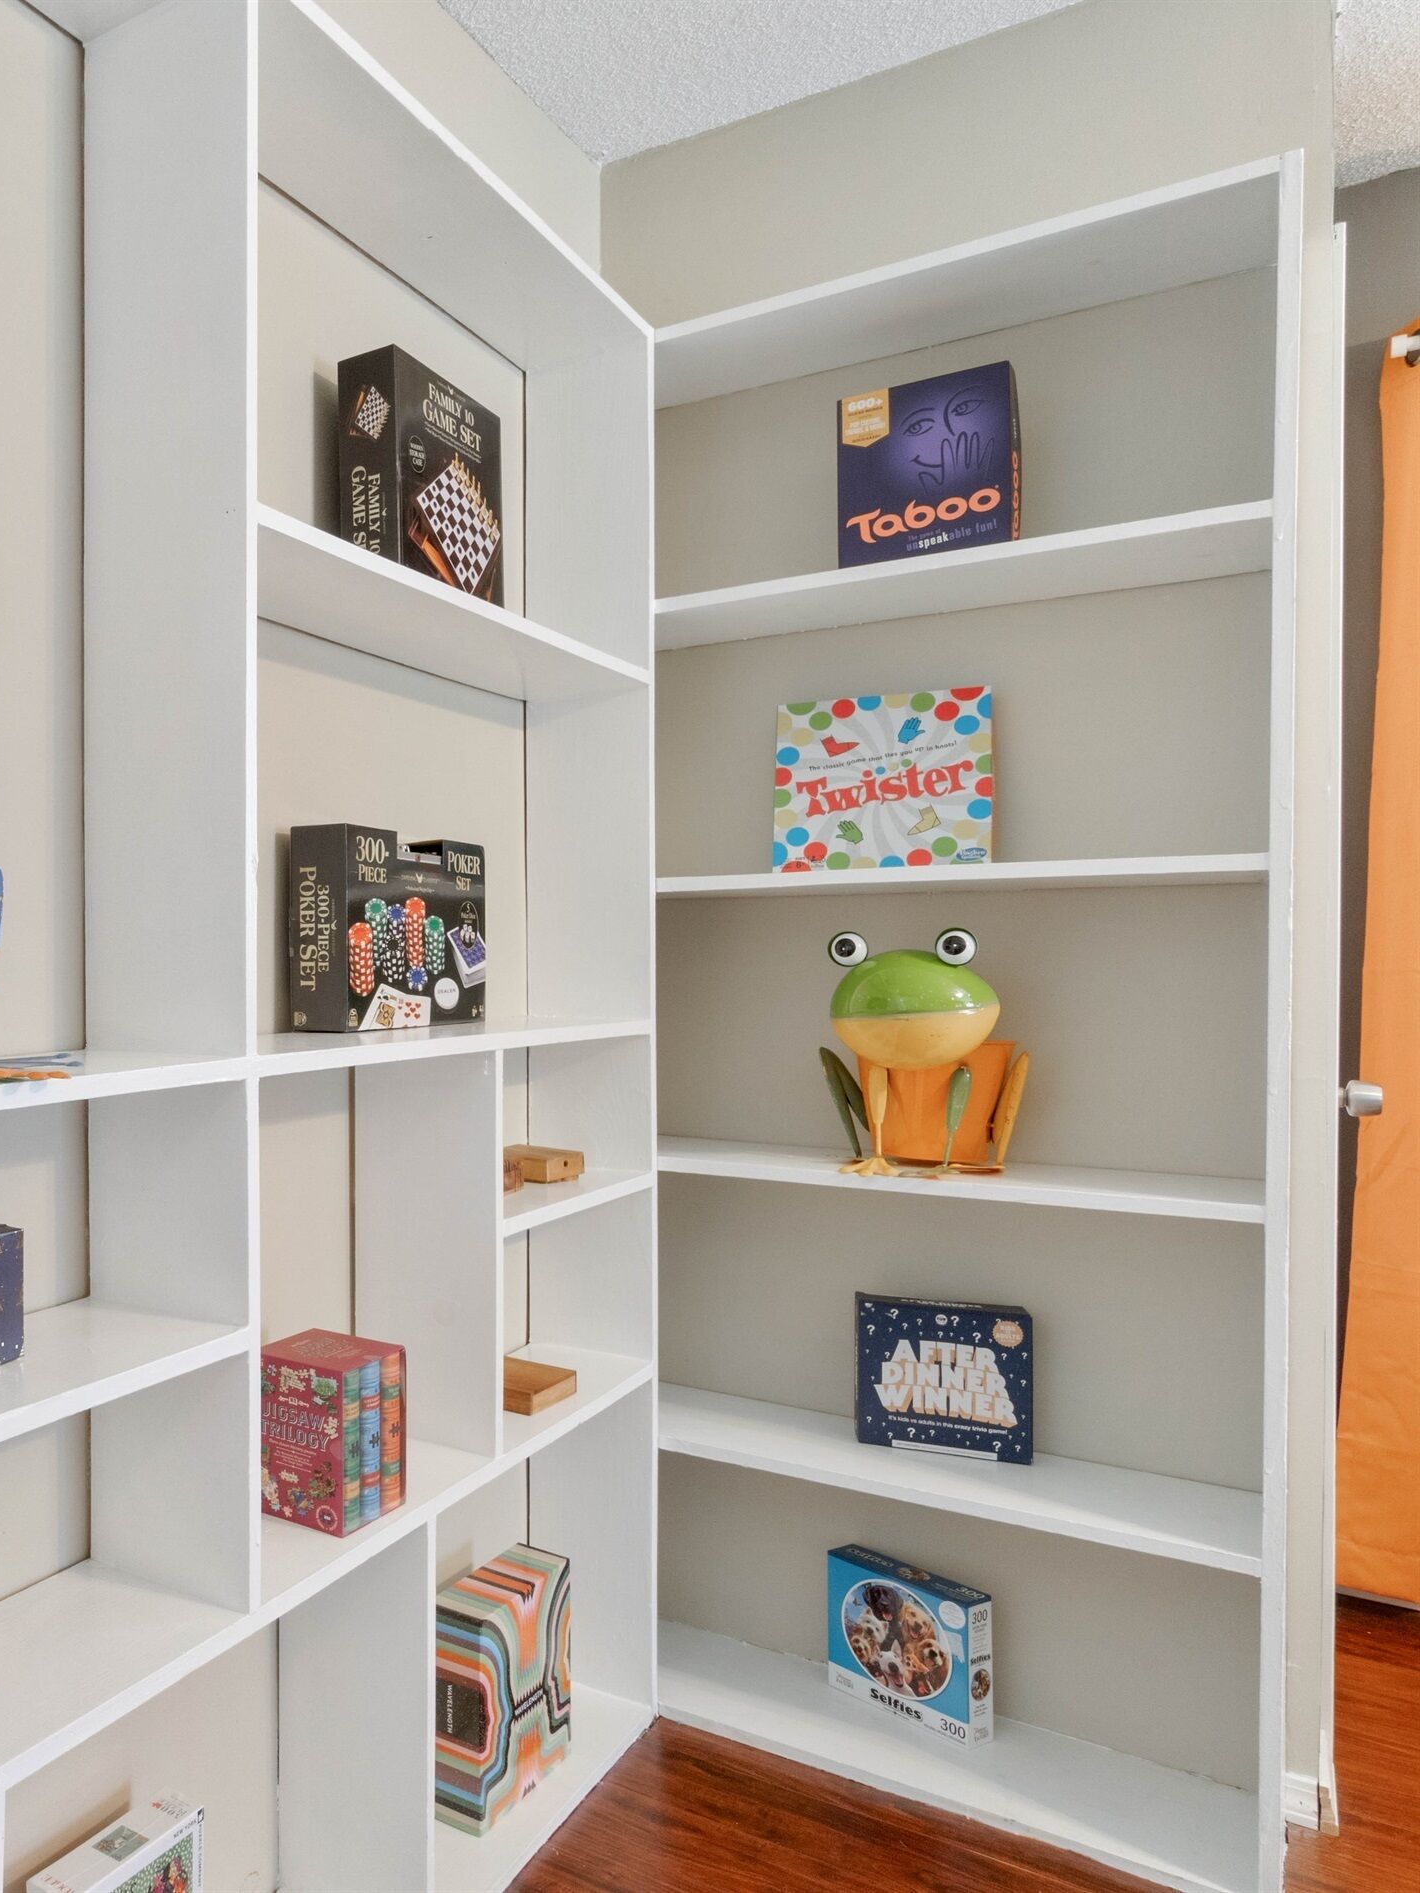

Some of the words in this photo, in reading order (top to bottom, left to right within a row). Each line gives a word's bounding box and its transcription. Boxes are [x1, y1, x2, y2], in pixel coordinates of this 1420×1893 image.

[428, 382, 462, 418] FAMILY
[464, 409, 475, 427] 10
[423, 399, 458, 437] GAME
[460, 424, 482, 452] SET
[351, 465, 366, 527] GAME
[368, 473, 381, 532] FAMILY
[846, 488, 1001, 543] Taboo
[369, 539, 381, 554] 10
[906, 527, 972, 551] unspeakable
[975, 518, 998, 534] fun!
[823, 761, 845, 770] classic
[846, 757, 867, 766] game
[900, 749, 913, 757] you
[935, 740, 958, 750] knots!
[795, 760, 974, 818] Twister
[358, 864, 387, 884] PIECE
[447, 851, 480, 876] POKER
[455, 875, 472, 892] SET
[299, 866, 317, 938] POKER
[317, 884, 330, 973] 300-PIECE
[299, 944, 318, 992] SET
[890, 1339, 1000, 1374] AFTER
[882, 1362, 1010, 1400] DINNER
[263, 1402, 326, 1431] JIGSAW
[873, 1384, 1018, 1428] WINNER
[261, 1418, 330, 1452] TRILOGY
[954, 1424, 971, 1432] crazy
[972, 1425, 988, 1433] trivia
[955, 1586, 986, 1600] 300
[972, 1609, 988, 1625] 300
[970, 1653, 991, 1666] Selfies
[514, 1687, 544, 1716] WAVELENGTH
[870, 1688, 923, 1720] Selfies
[940, 1718, 966, 1739] 300
